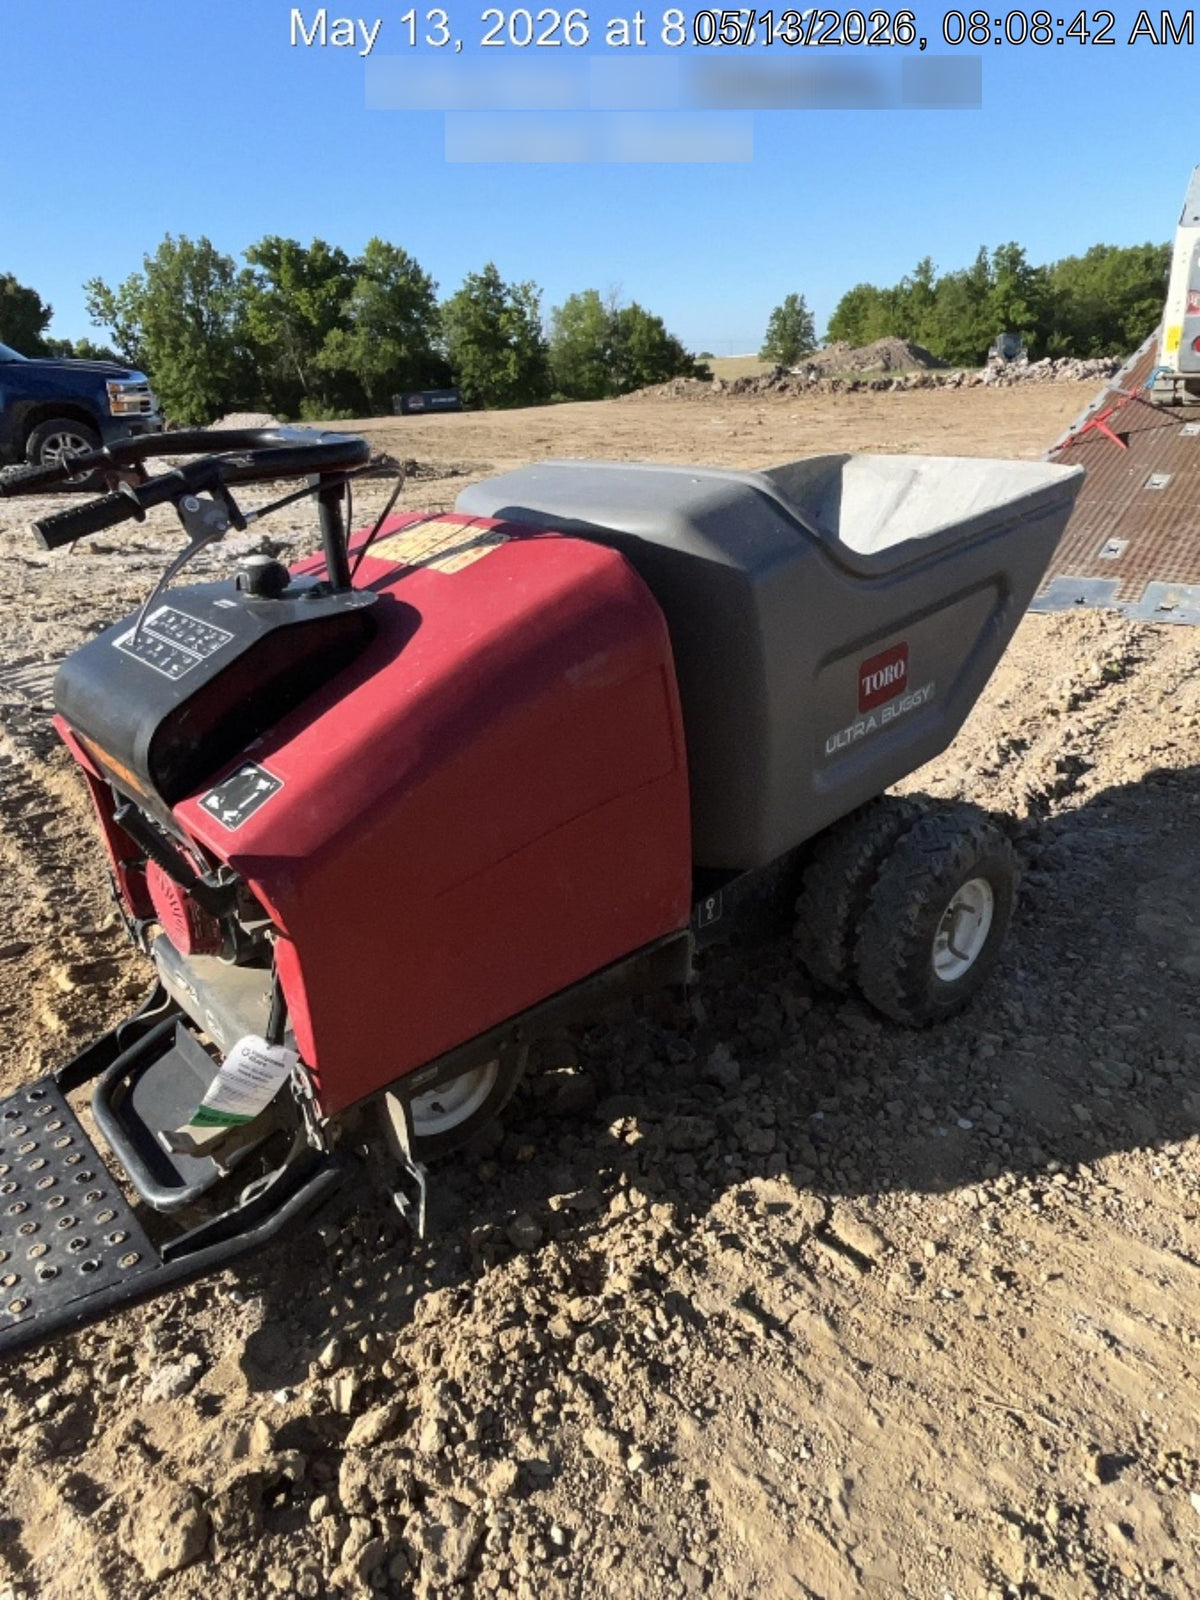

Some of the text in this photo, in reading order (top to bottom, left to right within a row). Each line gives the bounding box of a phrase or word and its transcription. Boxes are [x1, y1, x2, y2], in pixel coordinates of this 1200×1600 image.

[861, 659, 905, 696] TORO
[825, 683, 932, 754] ULTRA BUGGY
